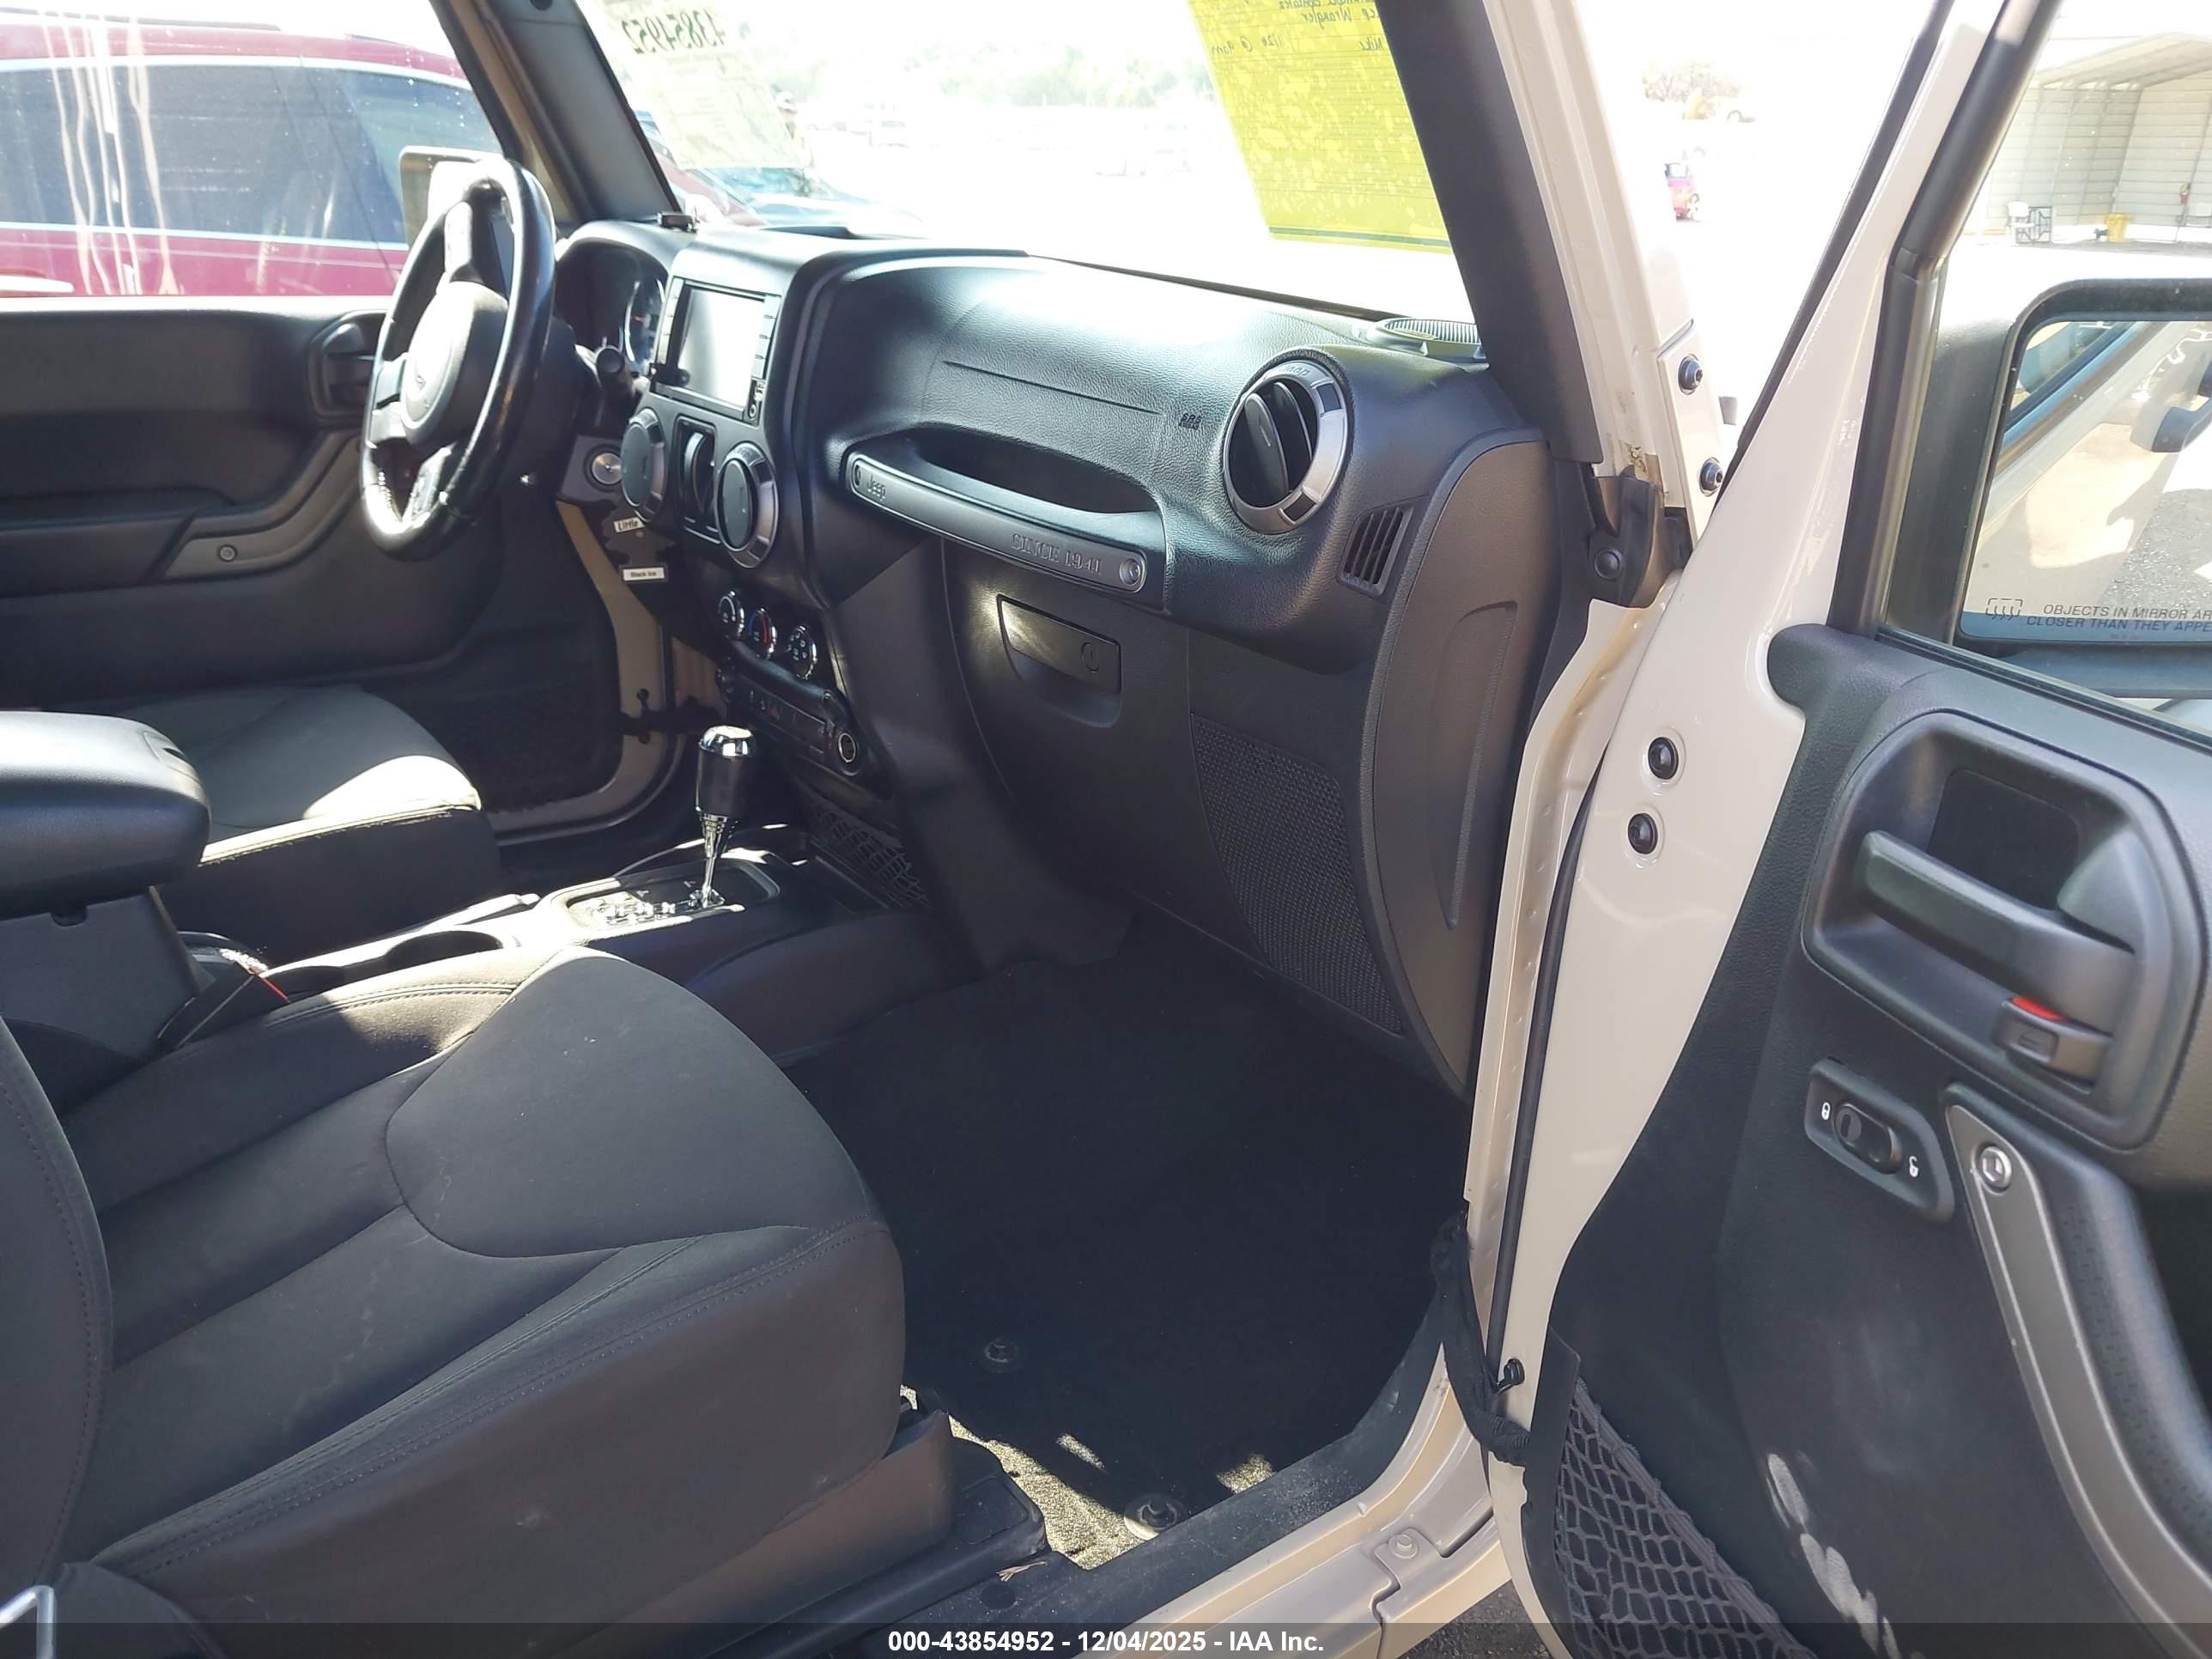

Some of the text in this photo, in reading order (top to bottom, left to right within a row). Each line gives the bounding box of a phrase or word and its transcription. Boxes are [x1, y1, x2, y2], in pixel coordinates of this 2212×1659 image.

[866, 473, 887, 502] Jeep
[1010, 532, 1103, 576] SINCE 1941
[2027, 615, 2212, 633] CLOSER THAN THEY APPE
[2042, 604, 2212, 621] OBJECTS IN MIRROR AR
